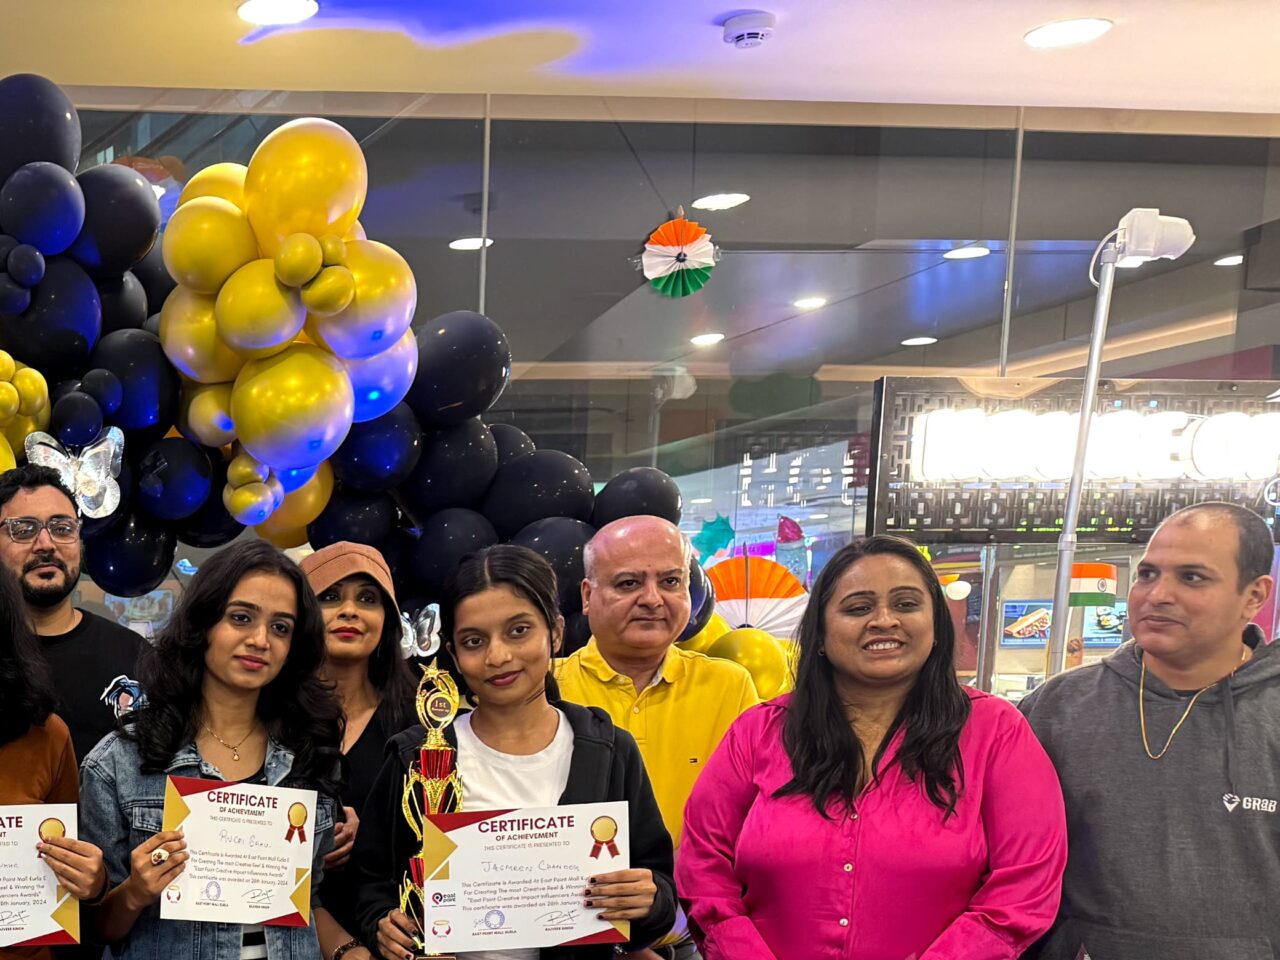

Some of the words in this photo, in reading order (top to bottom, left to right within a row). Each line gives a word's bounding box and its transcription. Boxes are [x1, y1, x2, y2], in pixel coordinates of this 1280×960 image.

[435, 700, 446, 708] 1st
[207, 790, 278, 808] CERTIFICATE
[228, 807, 265, 816] ACHIEVEMENT
[478, 816, 574, 832] CERTIFICATE
[507, 831, 558, 840] ACHIEVEMENT
